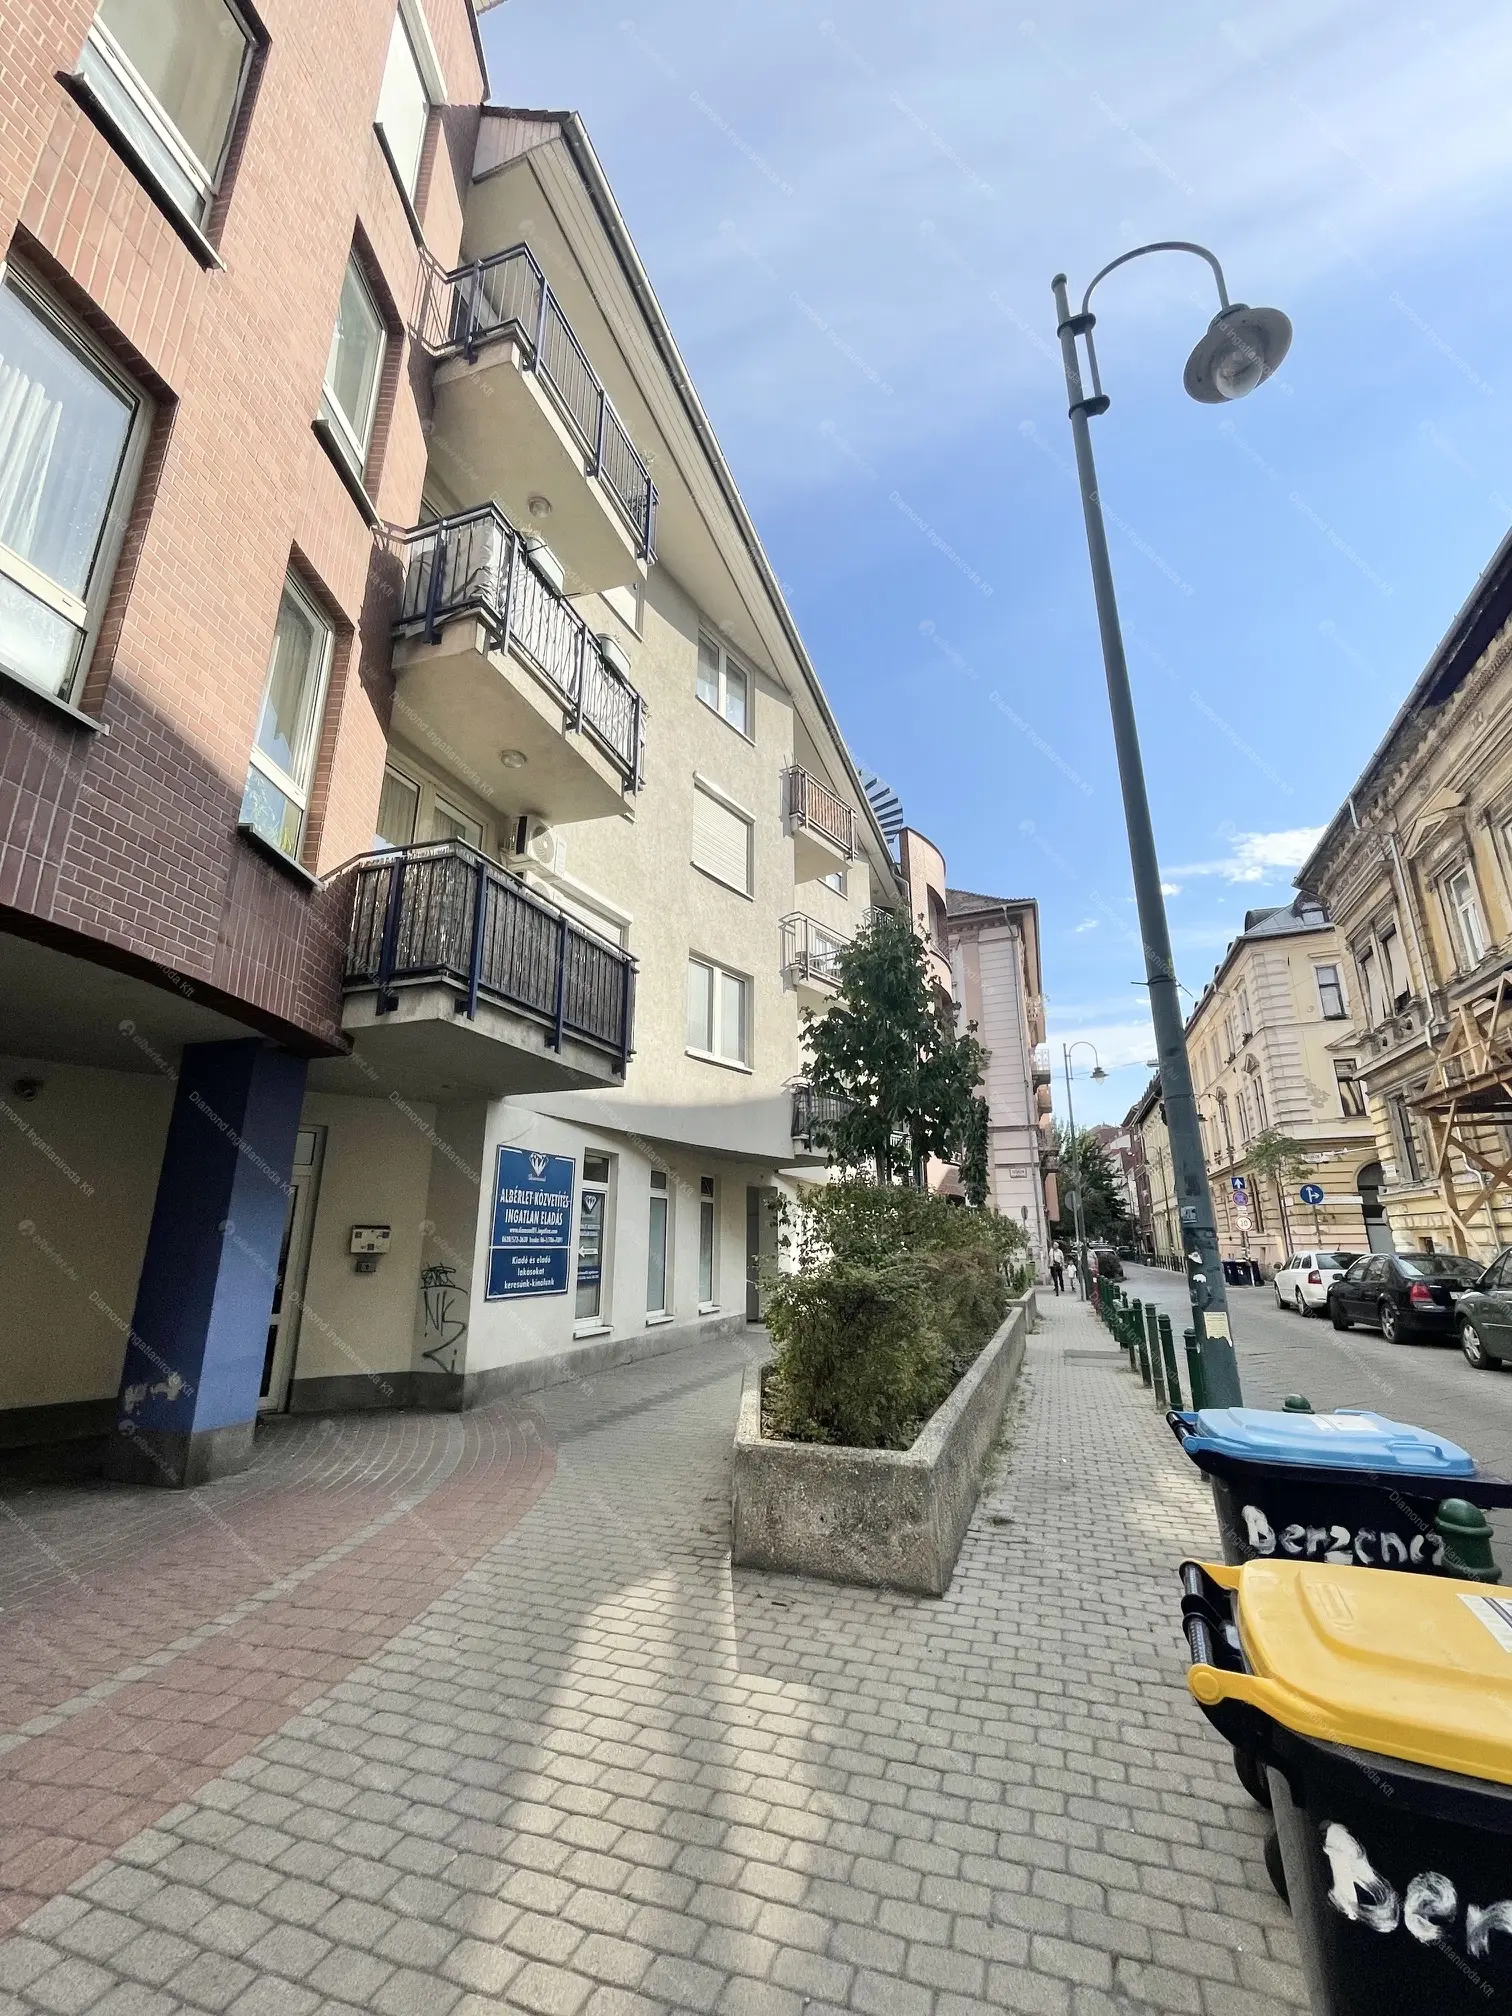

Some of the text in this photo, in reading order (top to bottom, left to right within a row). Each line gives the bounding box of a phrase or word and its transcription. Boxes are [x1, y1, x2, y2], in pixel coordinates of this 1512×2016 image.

[505, 1208, 563, 1226] INGATLAN ELADÁS
[511, 1255, 551, 1265] Kiadó és eladó
